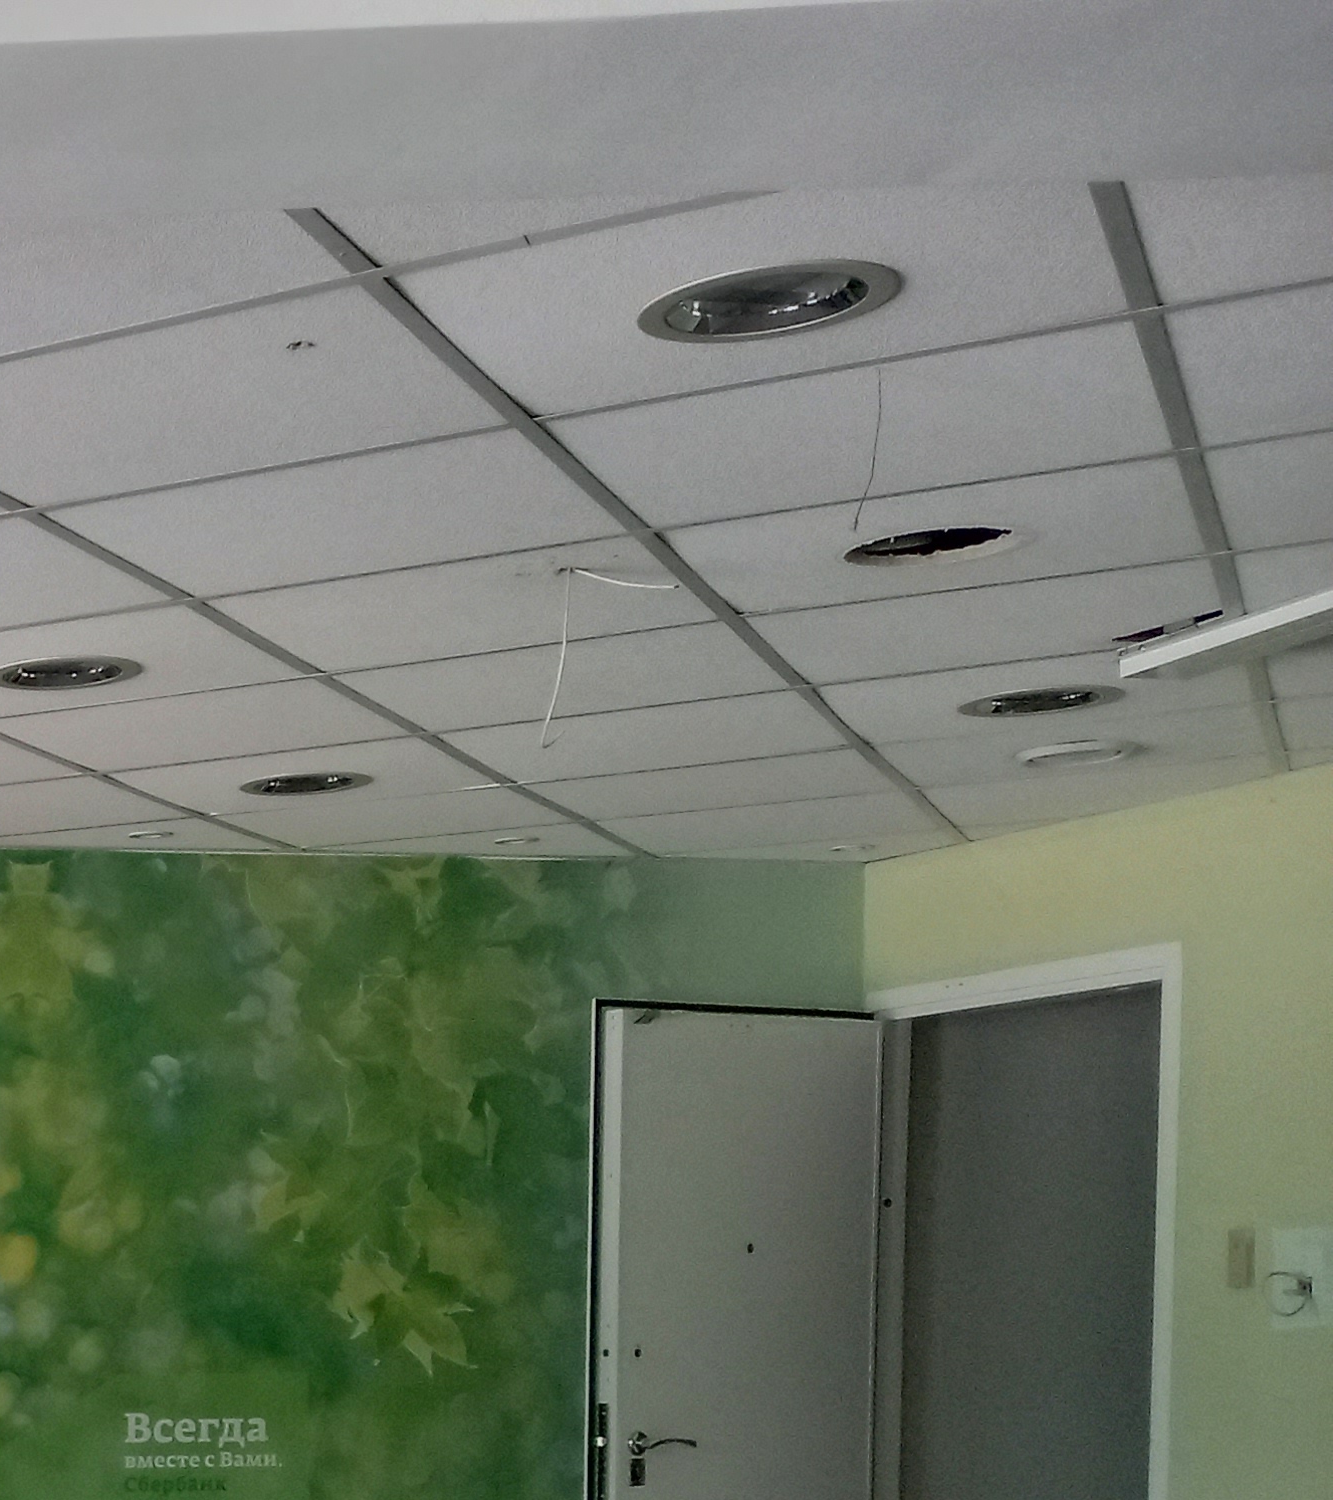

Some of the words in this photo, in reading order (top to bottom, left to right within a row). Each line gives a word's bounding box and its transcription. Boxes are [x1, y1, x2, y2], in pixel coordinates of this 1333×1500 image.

[124, 1412, 269, 1448] Всегда
[124, 1454, 201, 1469] вместе
[204, 1454, 215, 1468] с
[219, 1451, 283, 1468] Вами.
[124, 1475, 227, 1494] Сбербанк
